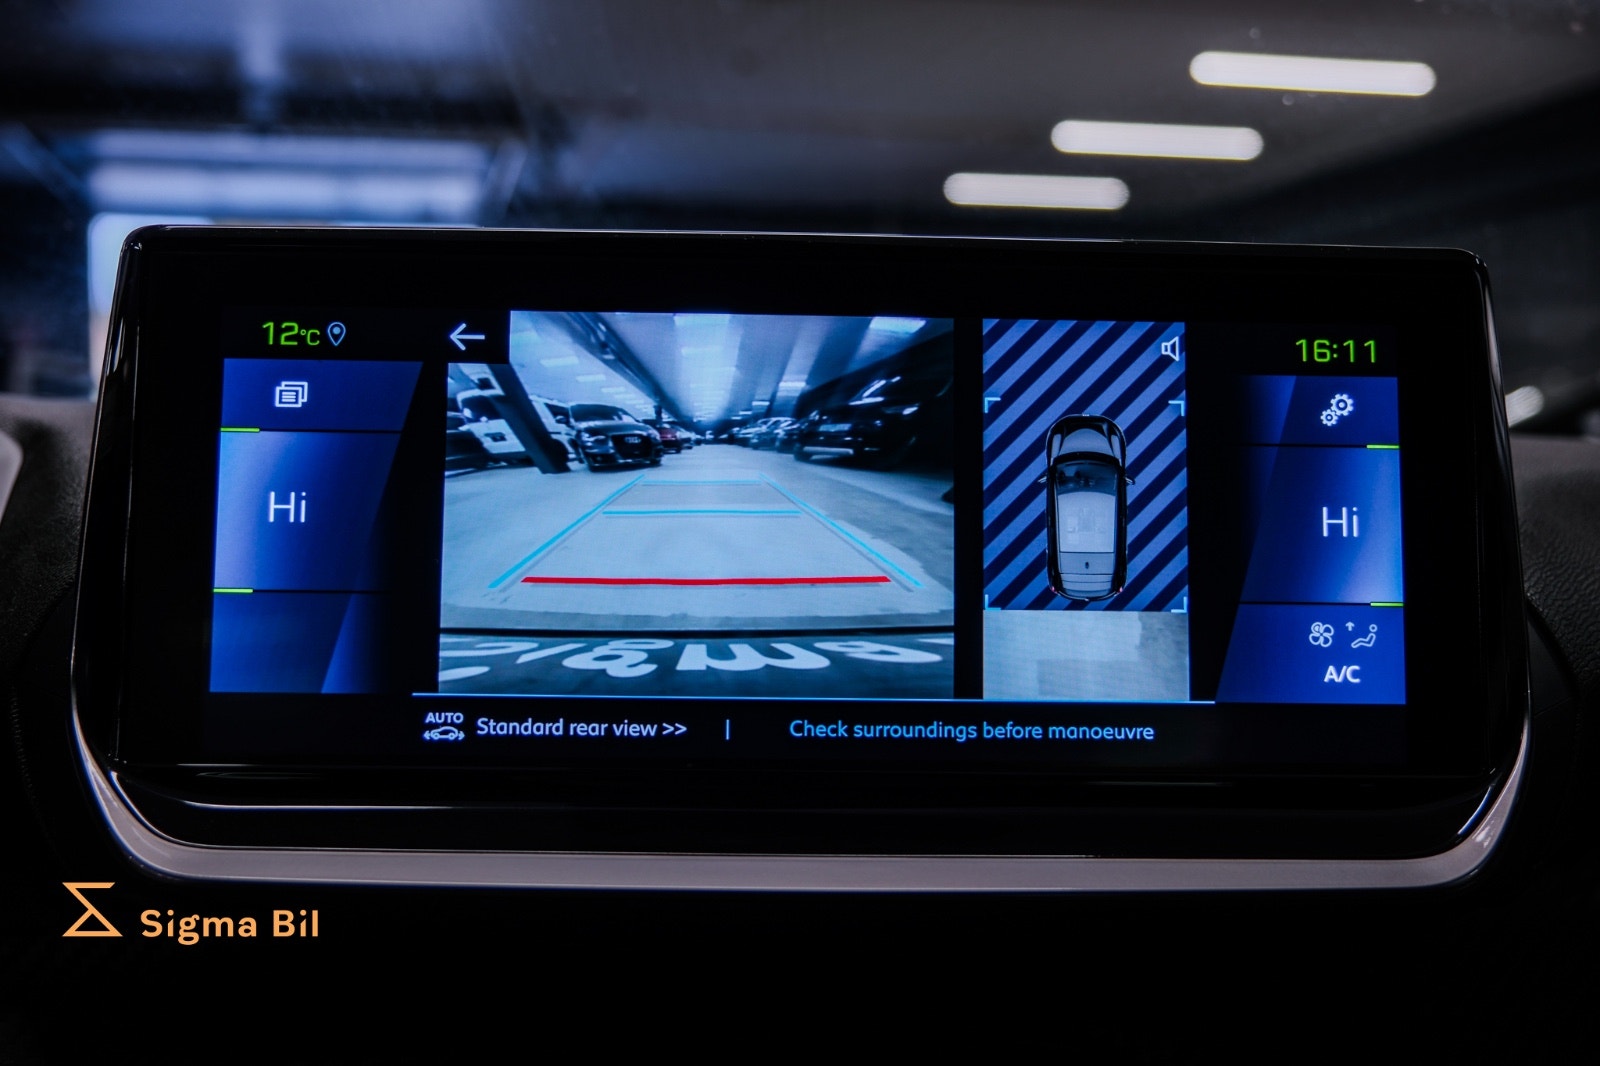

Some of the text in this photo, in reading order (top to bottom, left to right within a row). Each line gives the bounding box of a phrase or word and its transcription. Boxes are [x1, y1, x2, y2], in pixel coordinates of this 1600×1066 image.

[261, 321, 321, 346] 12°C
[1295, 338, 1377, 364] 16:11
[268, 490, 307, 523] Hi
[1321, 505, 1359, 538] Hi
[1323, 665, 1361, 684] A/C
[425, 711, 464, 725] AUTO
[476, 717, 564, 736] Standard
[569, 720, 609, 737] rear
[612, 719, 658, 737] view
[789, 720, 1155, 742] Check surroundings before manoeuvre
